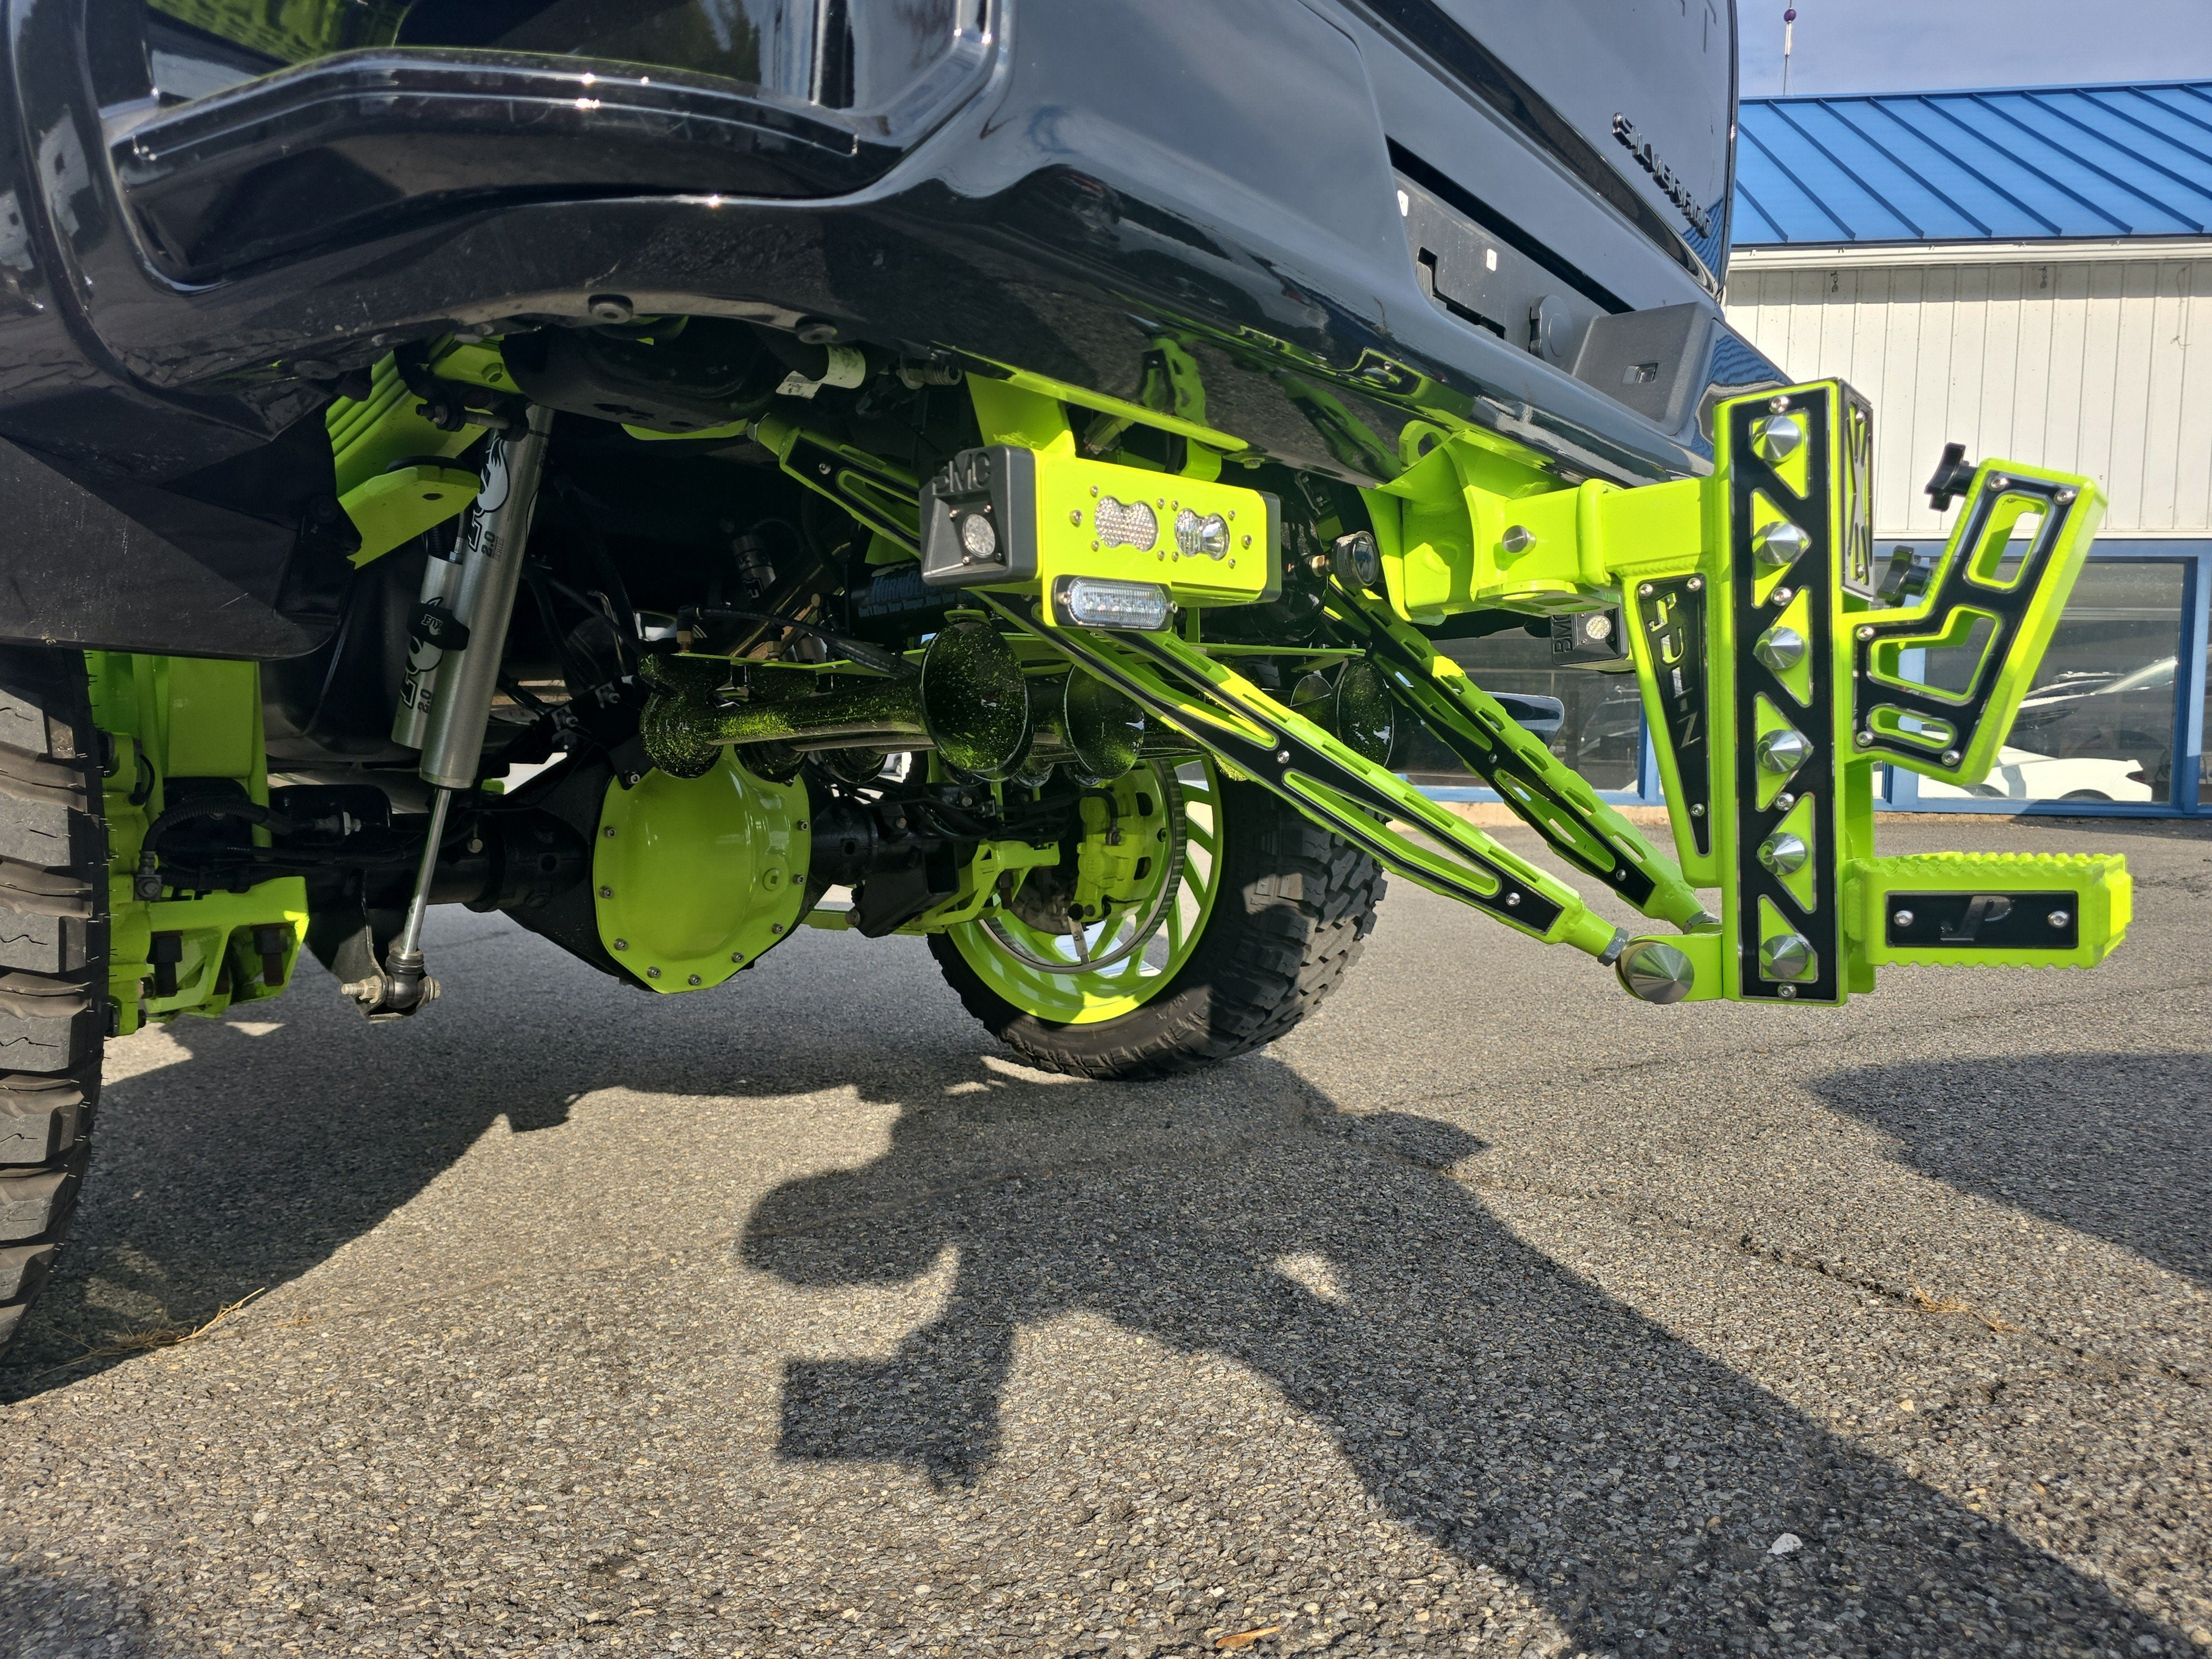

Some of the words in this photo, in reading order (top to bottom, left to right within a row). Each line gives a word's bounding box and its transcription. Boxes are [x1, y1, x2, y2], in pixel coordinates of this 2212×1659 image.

[480, 530, 496, 558] 2.0
[495, 537, 505, 562] SERIES
[421, 613, 443, 634] FOX
[418, 688, 433, 714] 2.0
